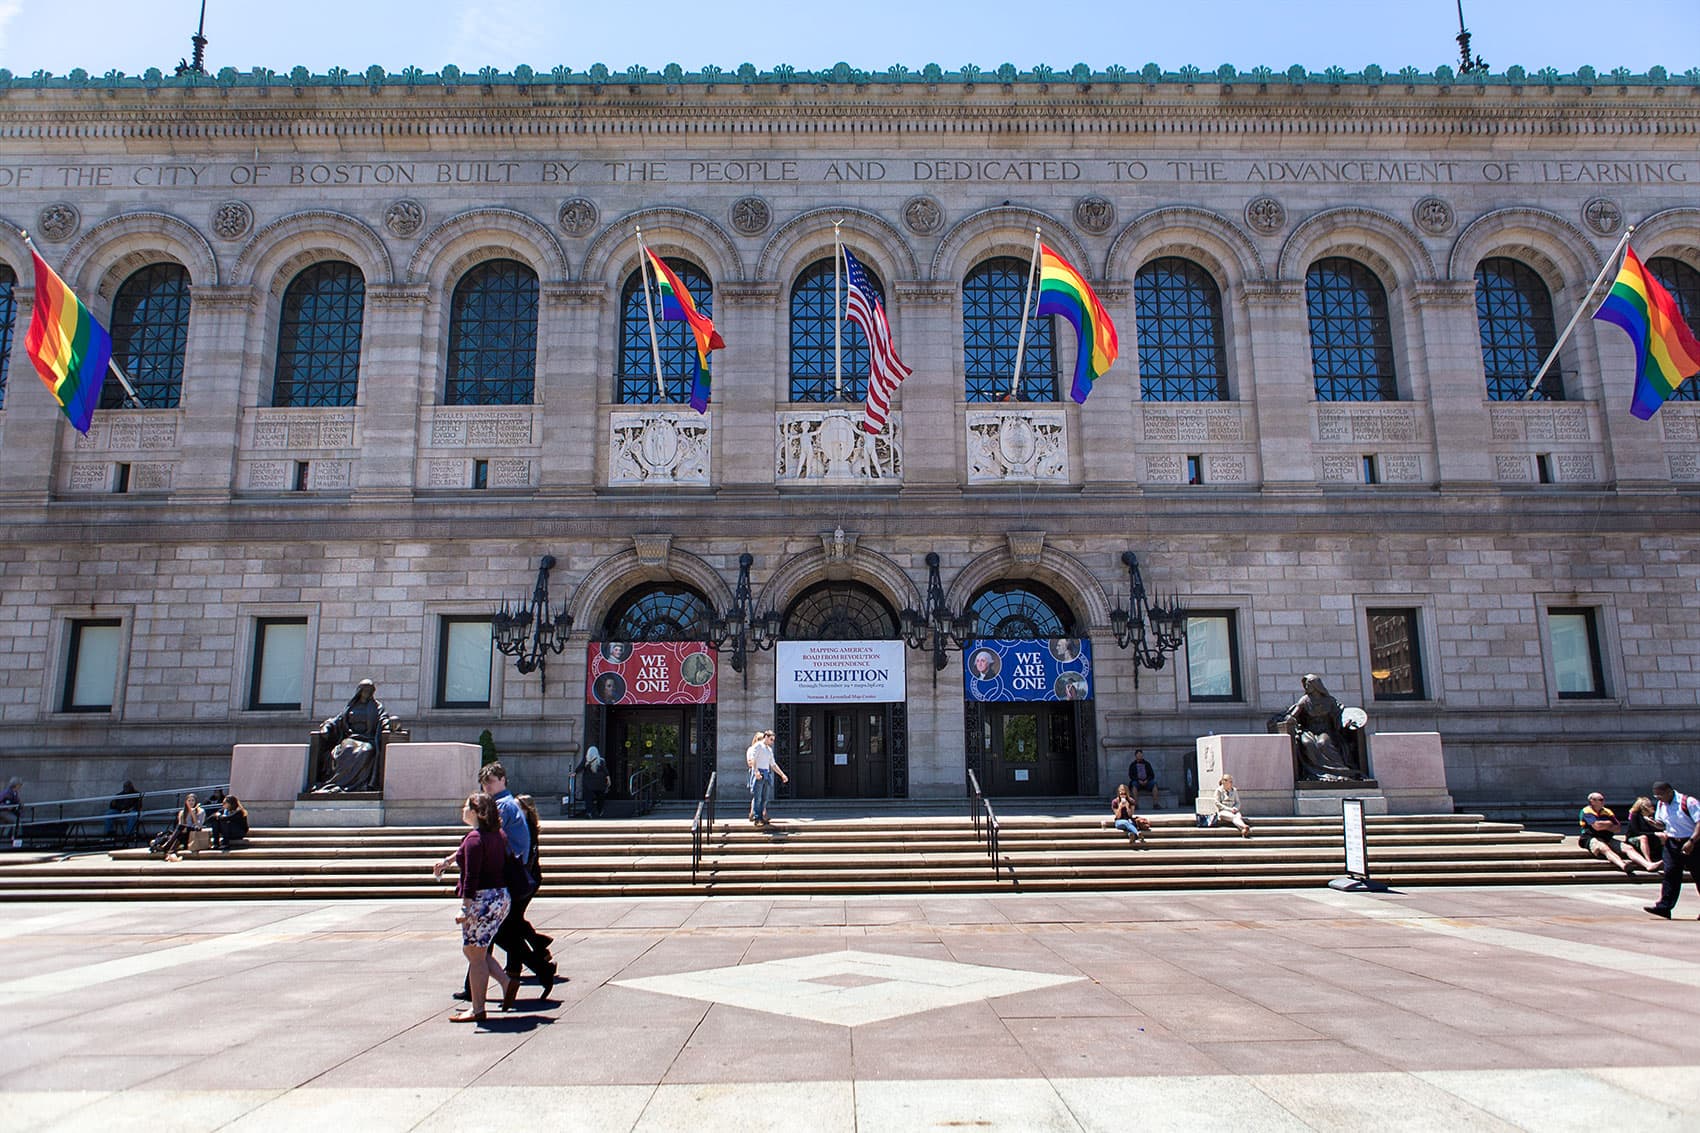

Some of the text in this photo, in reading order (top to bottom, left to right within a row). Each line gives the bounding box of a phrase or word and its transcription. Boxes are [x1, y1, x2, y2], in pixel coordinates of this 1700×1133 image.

[58, 167, 113, 187] THE
[133, 166, 207, 186] CITY
[231, 166, 271, 185] OF
[290, 165, 416, 184] BOSTON
[437, 163, 520, 183] BUILT
[542, 163, 579, 182] BY
[604, 162, 669, 181] THE
[690, 162, 800, 181] PEOPLE
[824, 162, 886, 181] AND
[914, 162, 1081, 181] DEDICATED
[1108, 162, 1147, 181] TO
[1167, 162, 1228, 181] THE
[1247, 162, 1459, 181] ADVANCEMENT
[1482, 162, 1520, 182] OF
[1543, 162, 1688, 182] LEARNING
[640, 654, 666, 666] WE
[1015, 652, 1042, 664] WE
[636, 667, 669, 679] ARE
[794, 669, 888, 682] EXHIBITION
[1013, 665, 1045, 676] ARE
[636, 680, 670, 692] ONE
[1012, 678, 1046, 690] ONE
